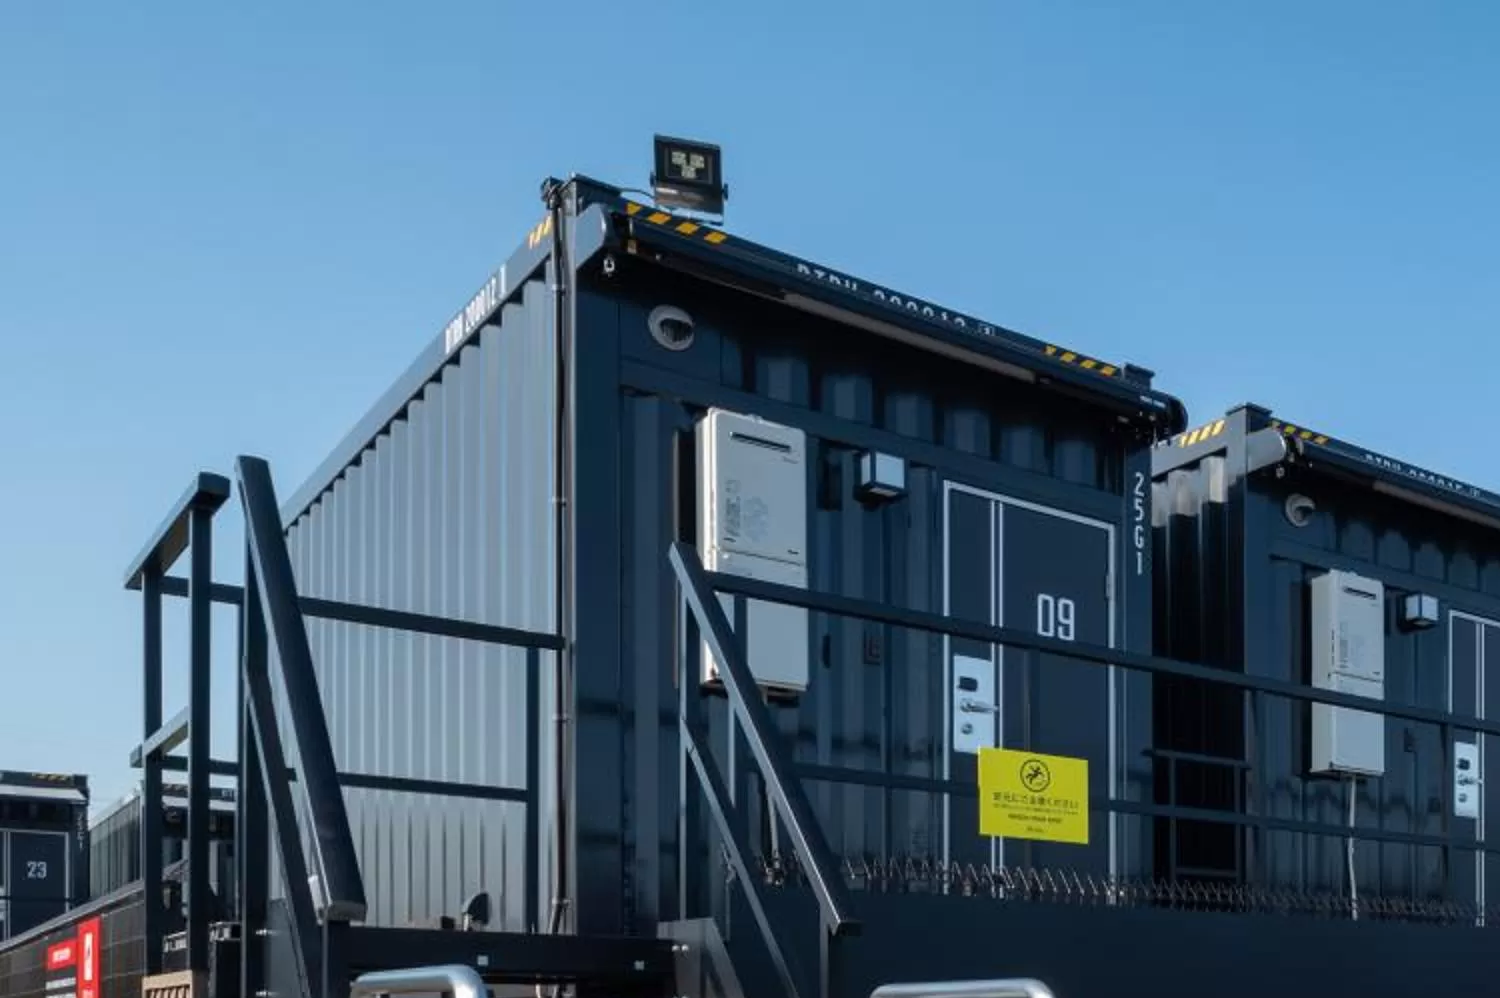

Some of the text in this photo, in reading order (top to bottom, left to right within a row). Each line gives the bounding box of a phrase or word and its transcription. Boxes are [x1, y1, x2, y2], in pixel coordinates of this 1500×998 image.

[1133, 471, 1146, 576] 25G1
[1037, 593, 1075, 641] 09
[27, 861, 47, 879] 23
